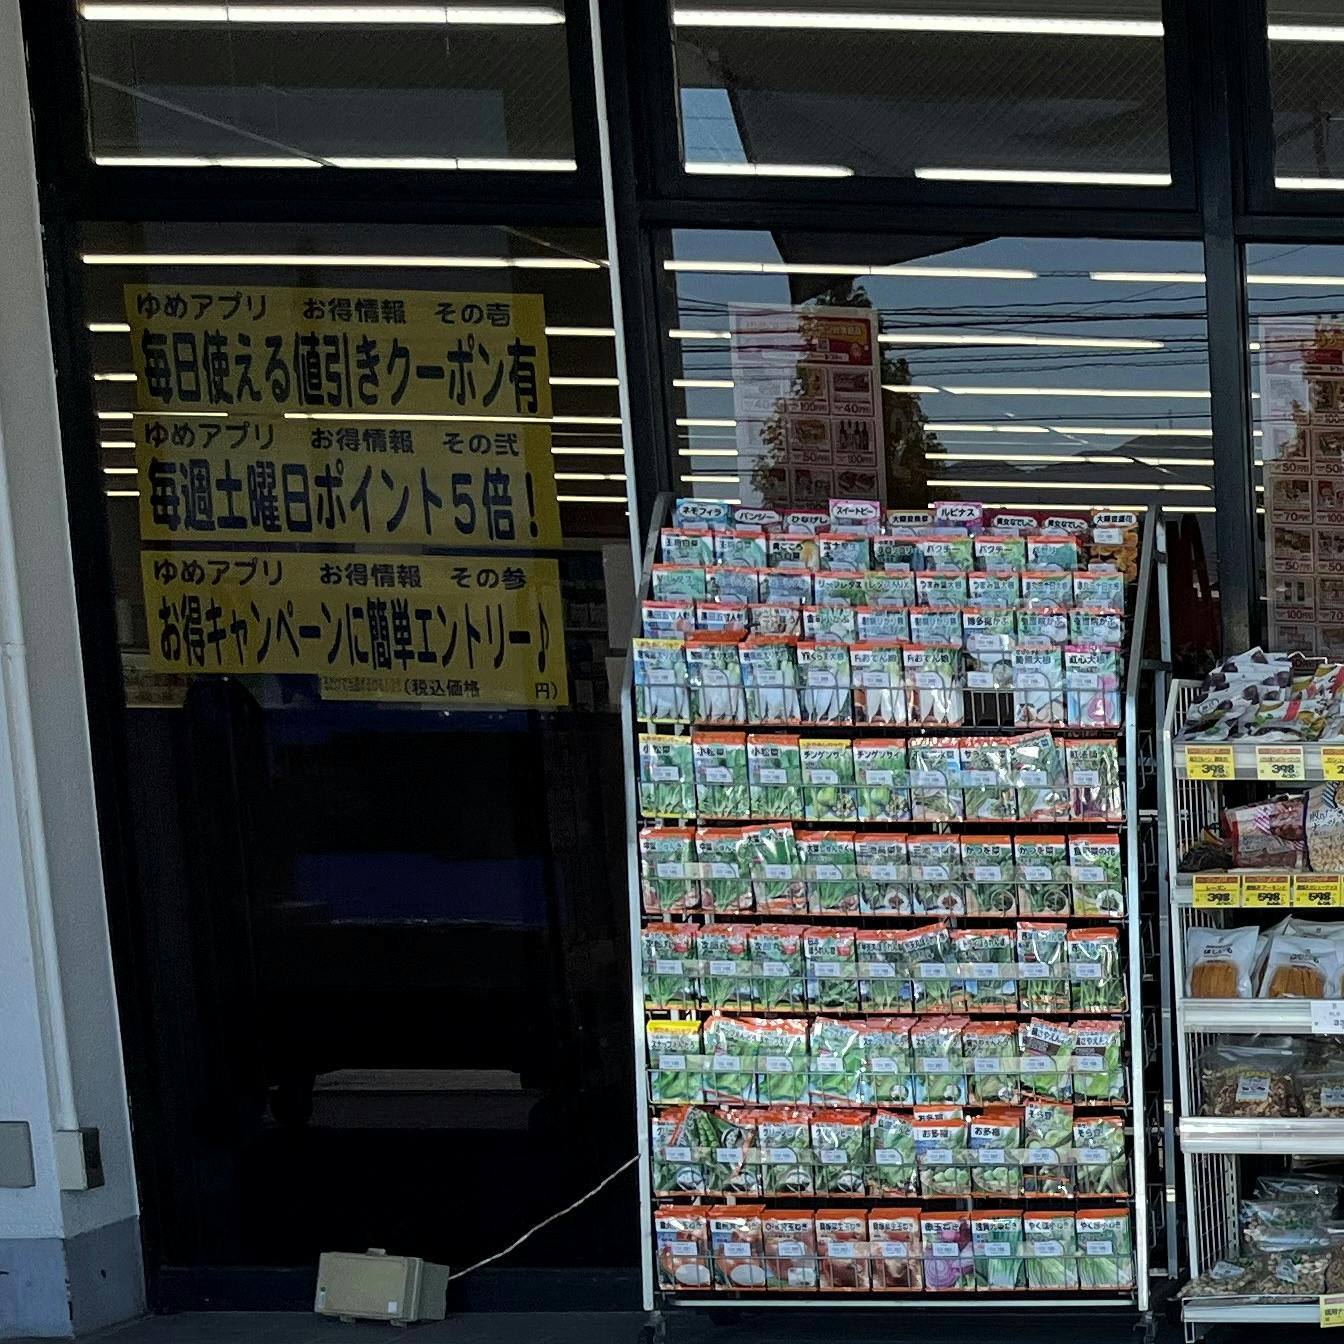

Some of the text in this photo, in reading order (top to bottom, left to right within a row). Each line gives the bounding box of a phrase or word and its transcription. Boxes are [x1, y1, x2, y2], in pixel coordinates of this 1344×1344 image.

[136, 293, 268, 320] ゆめアプリ
[303, 297, 407, 323] お得情報
[141, 330, 539, 414] 毎日使える値引きクーポン有
[145, 422, 275, 449] ゆめアプリ
[311, 427, 415, 453] お得情報
[682, 506, 721, 516] ネモフィラ
[791, 515, 828, 523] ひなげし
[837, 506, 873, 515] スイートピー
[941, 506, 975, 517] ルピナス
[153, 557, 284, 586] ゆめアプリ
[319, 562, 422, 588] お得情報
